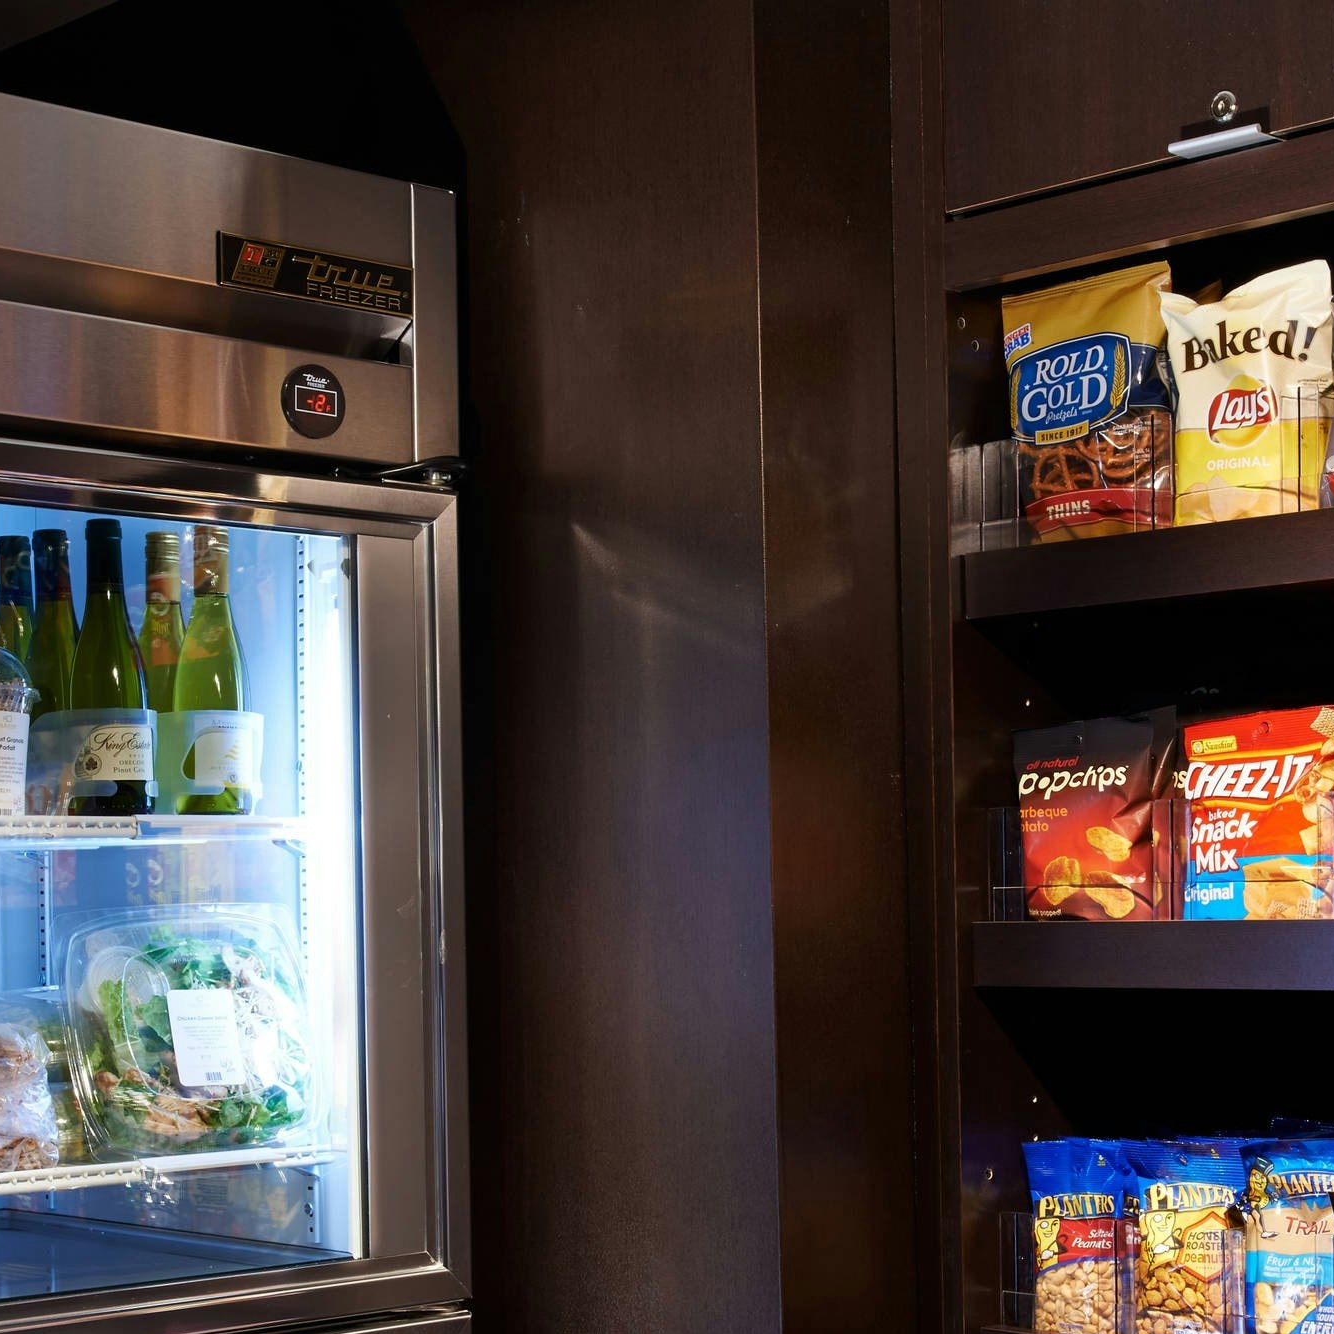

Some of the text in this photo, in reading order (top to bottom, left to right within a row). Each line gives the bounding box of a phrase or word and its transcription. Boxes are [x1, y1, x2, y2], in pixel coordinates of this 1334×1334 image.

[306, 282, 401, 310] FREEZER
[1181, 319, 1317, 373] Baked!
[1035, 345, 1105, 386] ROLD
[1021, 374, 1107, 423] GOLD
[1041, 427, 1083, 441] SINCE 1917
[1206, 456, 1270, 472] ORIGINAL
[1046, 501, 1090, 520] THINS
[90, 732, 125, 758] King
[1027, 756, 1080, 771] all natural
[1186, 753, 1314, 800] CHEEZ-IT
[1208, 808, 1237, 820] baked
[1195, 844, 1239, 875] Mix
[1039, 1194, 1115, 1218] PLANTERS
